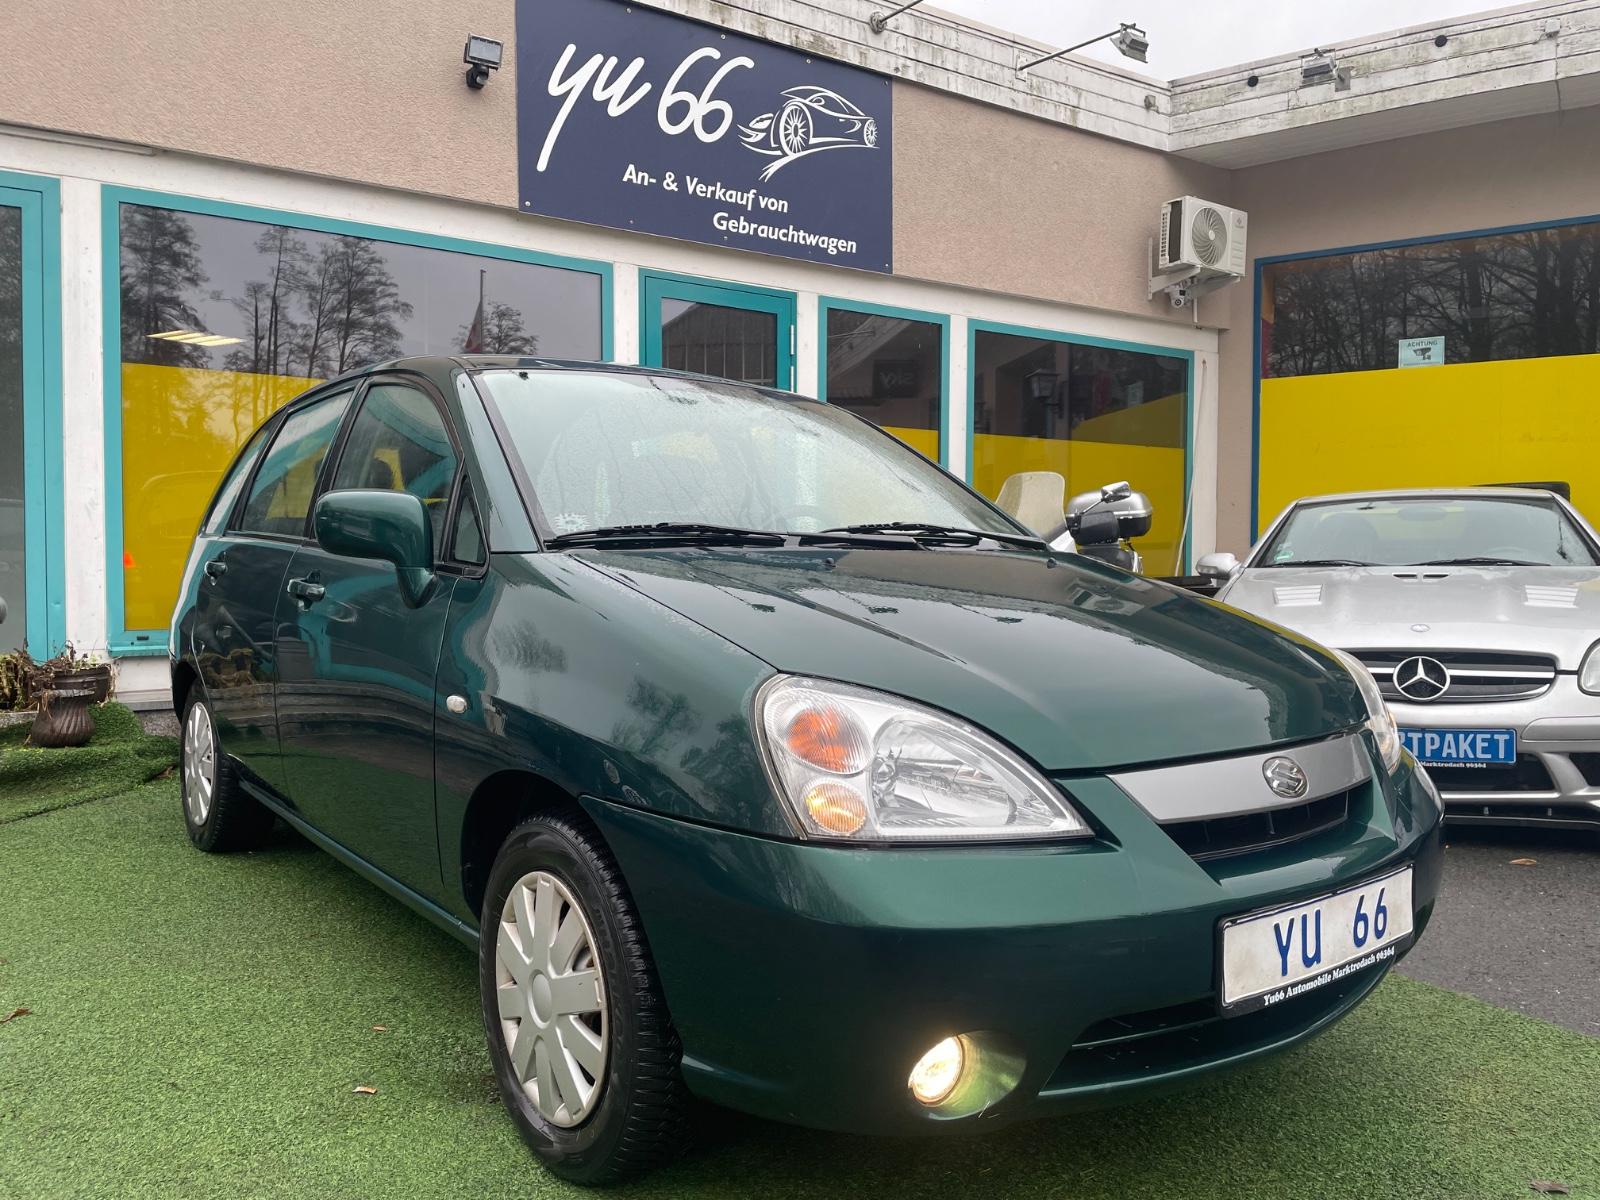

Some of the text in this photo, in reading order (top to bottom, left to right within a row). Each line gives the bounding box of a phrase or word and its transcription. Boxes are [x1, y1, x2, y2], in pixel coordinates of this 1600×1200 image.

[657, 46, 755, 143] 66
[622, 163, 789, 213] An- & Verkauf von
[712, 211, 857, 255] Gebrauchtwagen
[1273, 887, 1387, 977] YU 66
[1263, 945, 1395, 1006] Yu66 Automobile Marktrodach 96364
